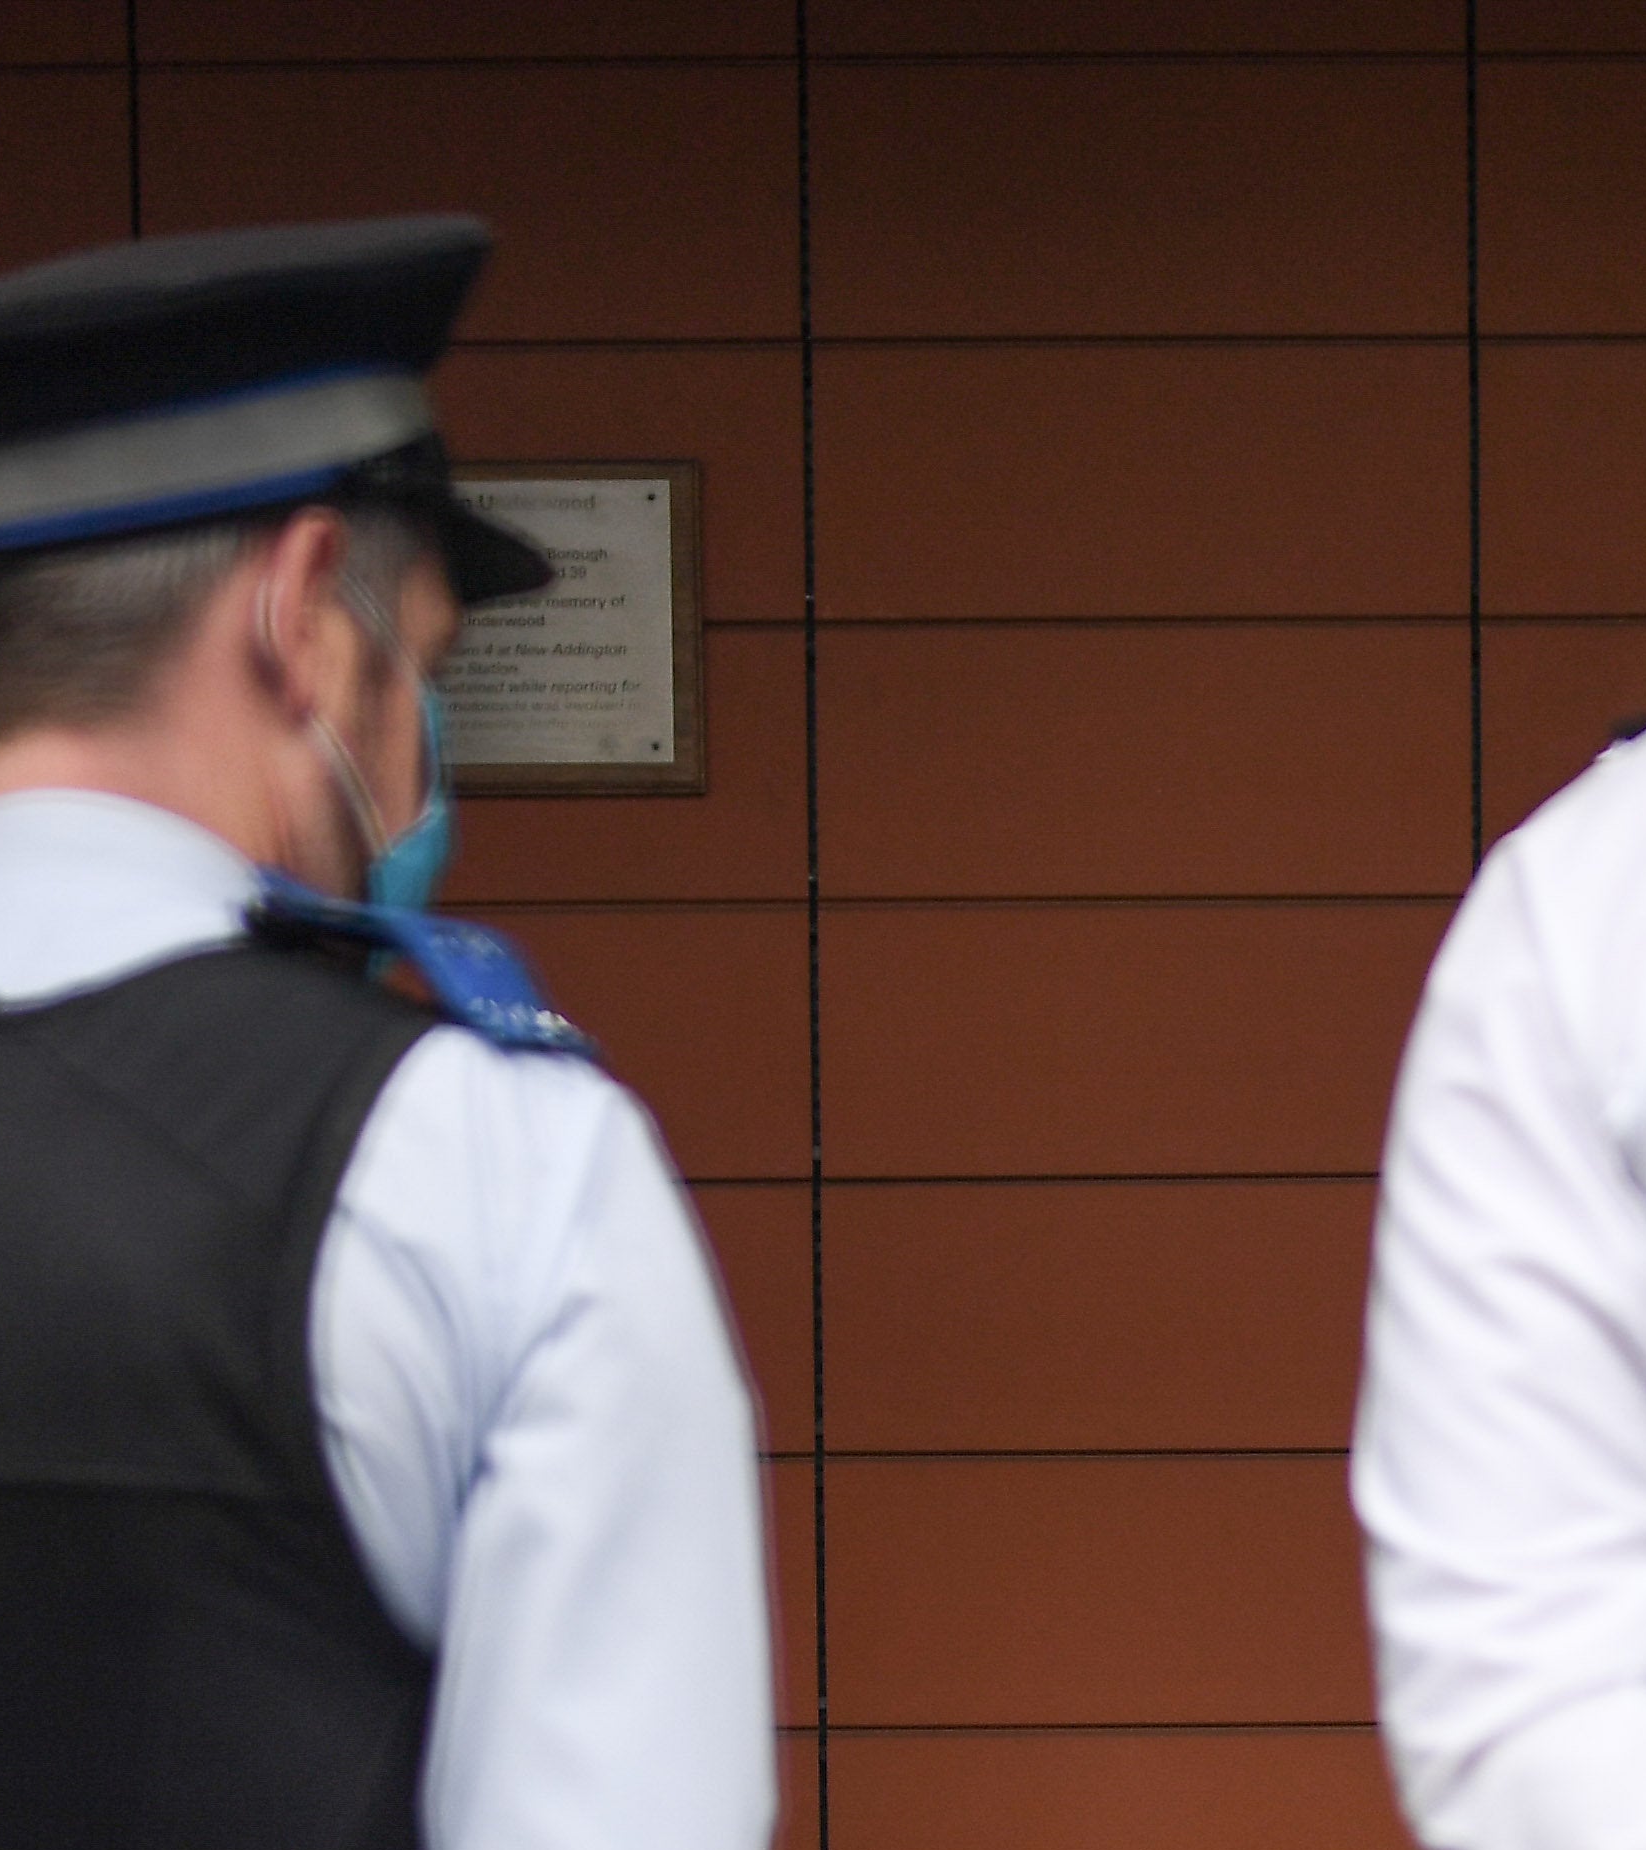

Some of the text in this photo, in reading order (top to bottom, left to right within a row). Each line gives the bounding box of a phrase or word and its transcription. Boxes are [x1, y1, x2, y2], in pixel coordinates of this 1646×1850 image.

[548, 547, 608, 563] Borough
[545, 596, 608, 610] memory
[610, 594, 627, 607] of
[485, 643, 494, 655] 4
[515, 643, 547, 655] New
[552, 642, 627, 658] Addington
[467, 660, 518, 674] Station
[509, 679, 546, 693] while
[550, 680, 617, 695] reporting
[620, 678, 641, 693] for
